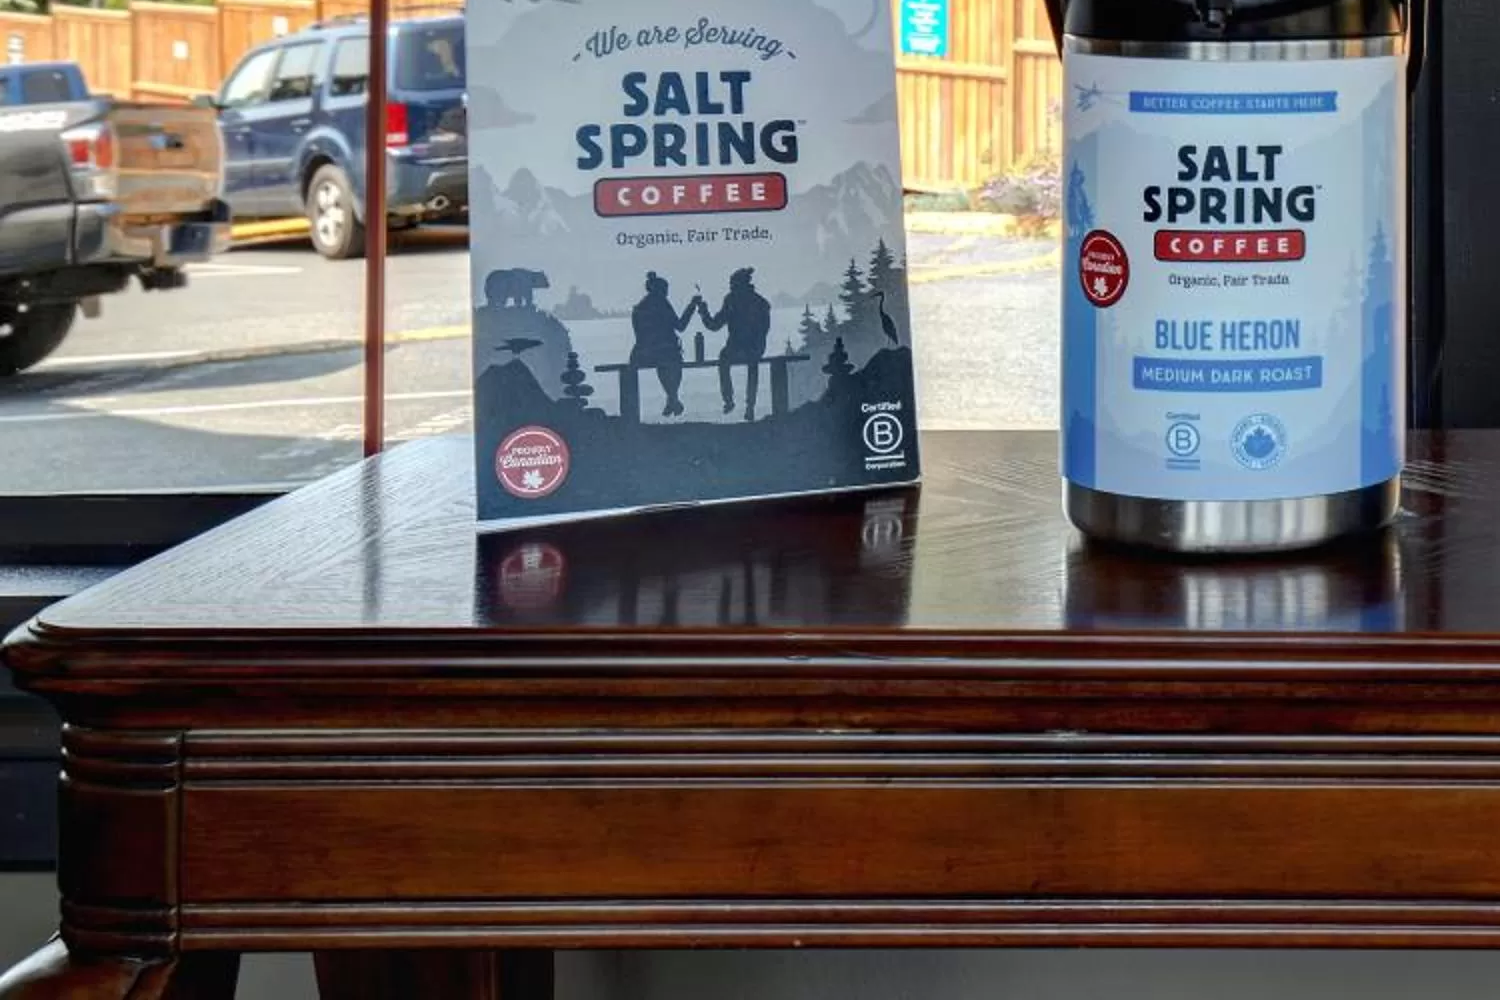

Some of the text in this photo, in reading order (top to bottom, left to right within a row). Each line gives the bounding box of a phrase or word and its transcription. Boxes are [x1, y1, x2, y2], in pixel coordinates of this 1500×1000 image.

[585, 16, 786, 61] We are Serving
[621, 70, 752, 117] SALT
[575, 120, 799, 170] SPRING
[1177, 145, 1283, 182] SALT
[617, 182, 767, 206] COFFEE
[1143, 185, 1316, 224] SPRING
[615, 231, 684, 249] Organic,
[687, 229, 718, 244] Fair
[1169, 237, 1290, 255] COFFEE
[1168, 273, 1222, 289] Organic,
[1223, 274, 1249, 287] Fair
[1155, 319, 1300, 351] BLUE HERON
[1142, 366, 1313, 384] MEDIUM DARK ROAST
[874, 421, 893, 445] B
[1175, 429, 1191, 450] B
